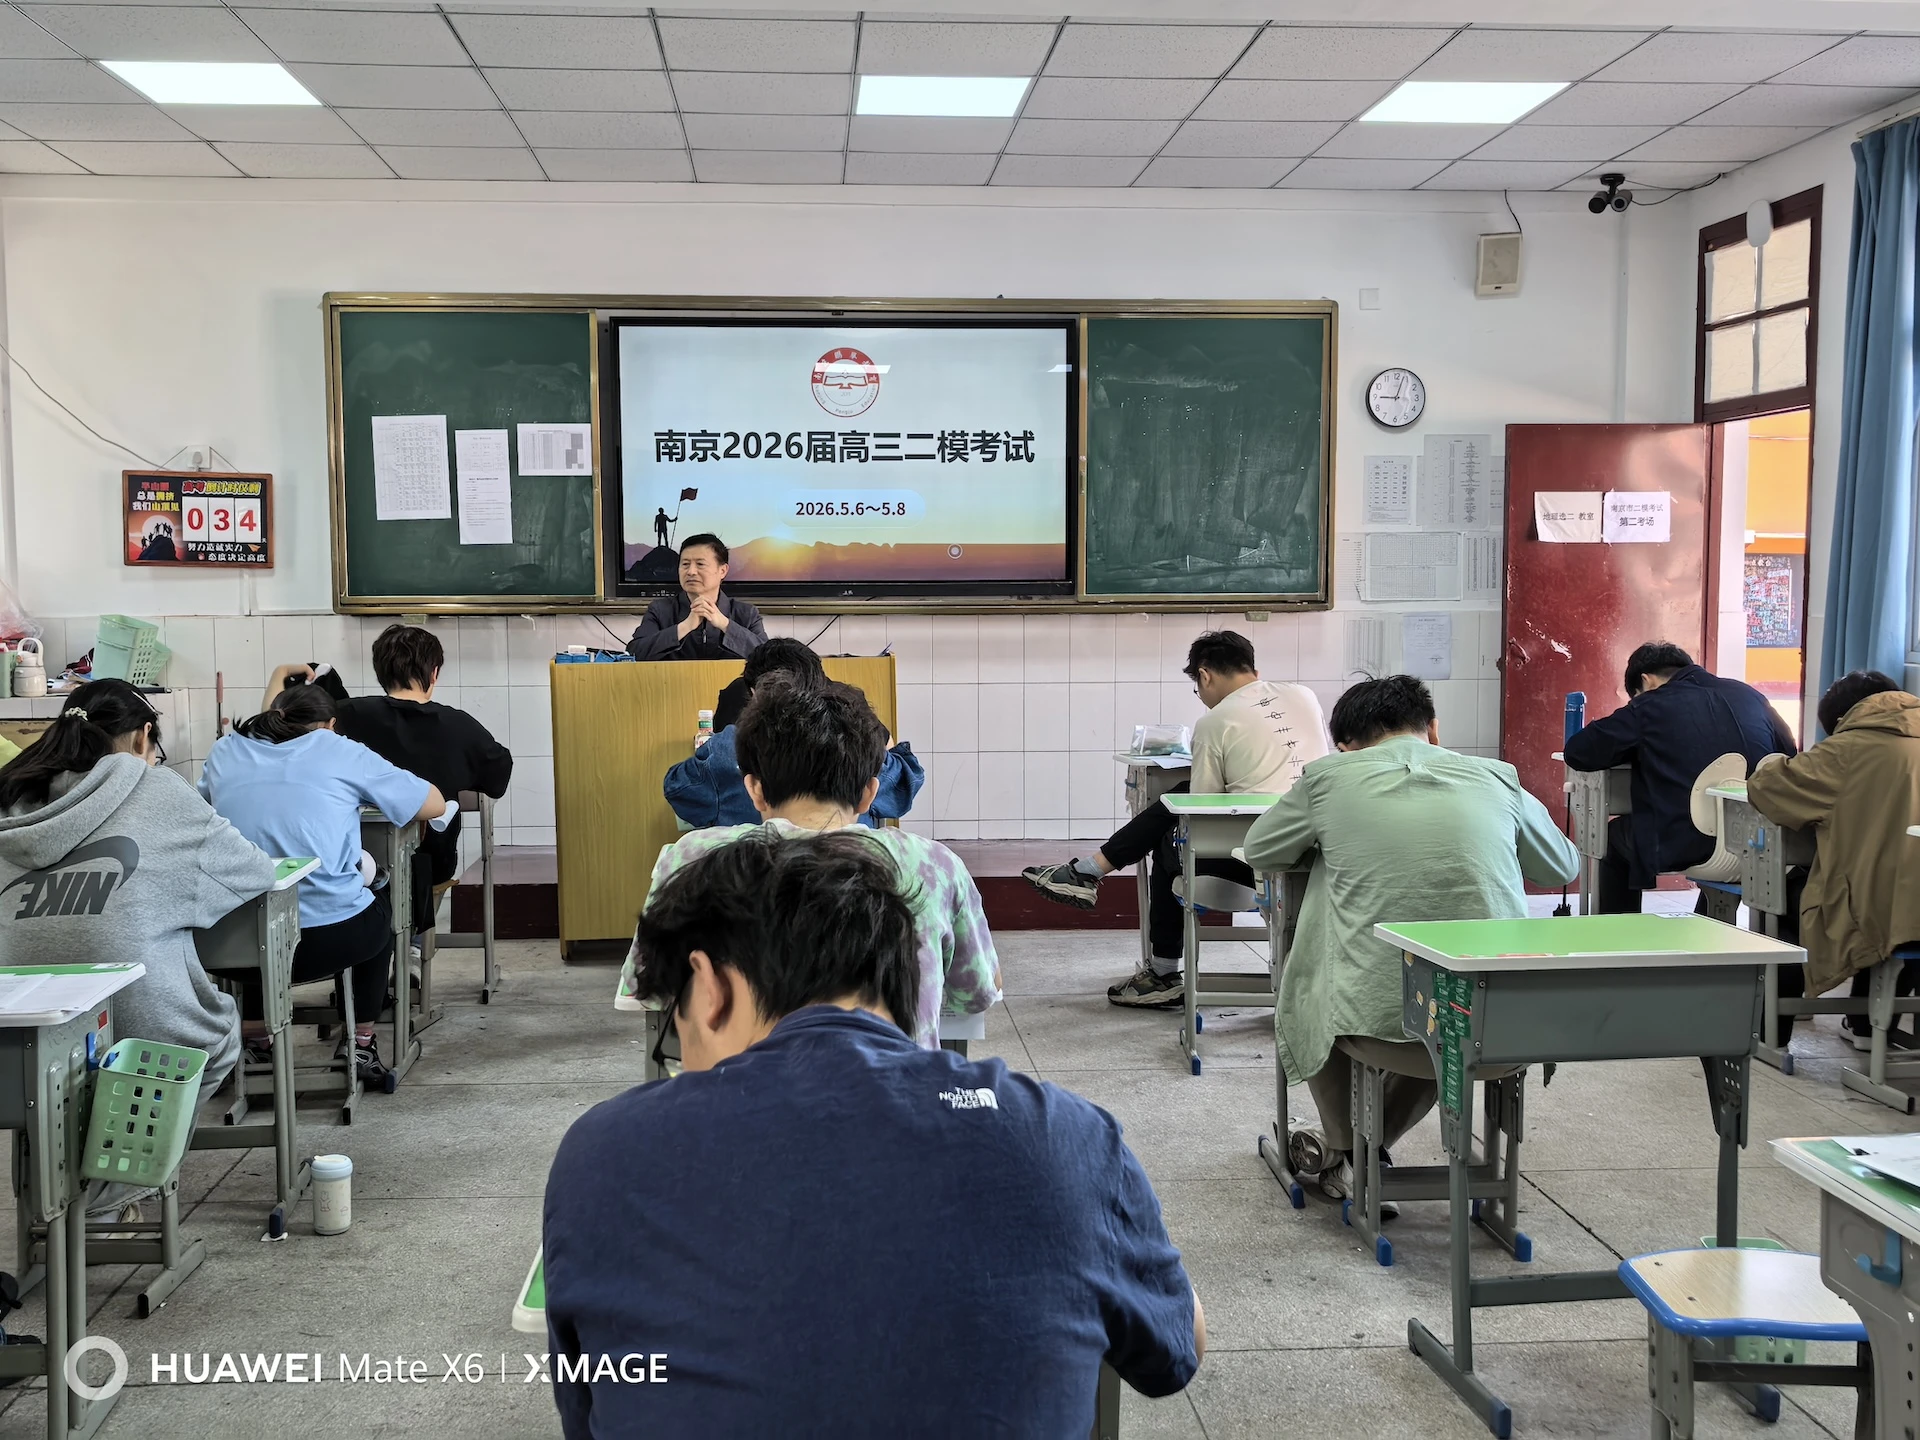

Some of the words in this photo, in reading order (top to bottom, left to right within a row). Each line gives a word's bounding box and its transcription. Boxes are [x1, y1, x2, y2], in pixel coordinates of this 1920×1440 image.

[654, 430, 1036, 464] 南京2026届高三二模考试
[182, 481, 261, 495] 高考倒计时仅剩
[136, 491, 175, 501] 总是拥挤
[132, 502, 180, 511] 我们山顶见
[1610, 504, 1664, 513] 南京市二模考试
[1578, 512, 1595, 521] 教室
[1619, 516, 1655, 527] 第二考场
[187, 543, 243, 552] 努力造就实力
[208, 553, 266, 562] 态度决定高度
[14, 872, 119, 920] NIKE
[955, 1086, 976, 1095] THE
[938, 1091, 978, 1101] NORTH
[952, 1100, 980, 1109] FACE
